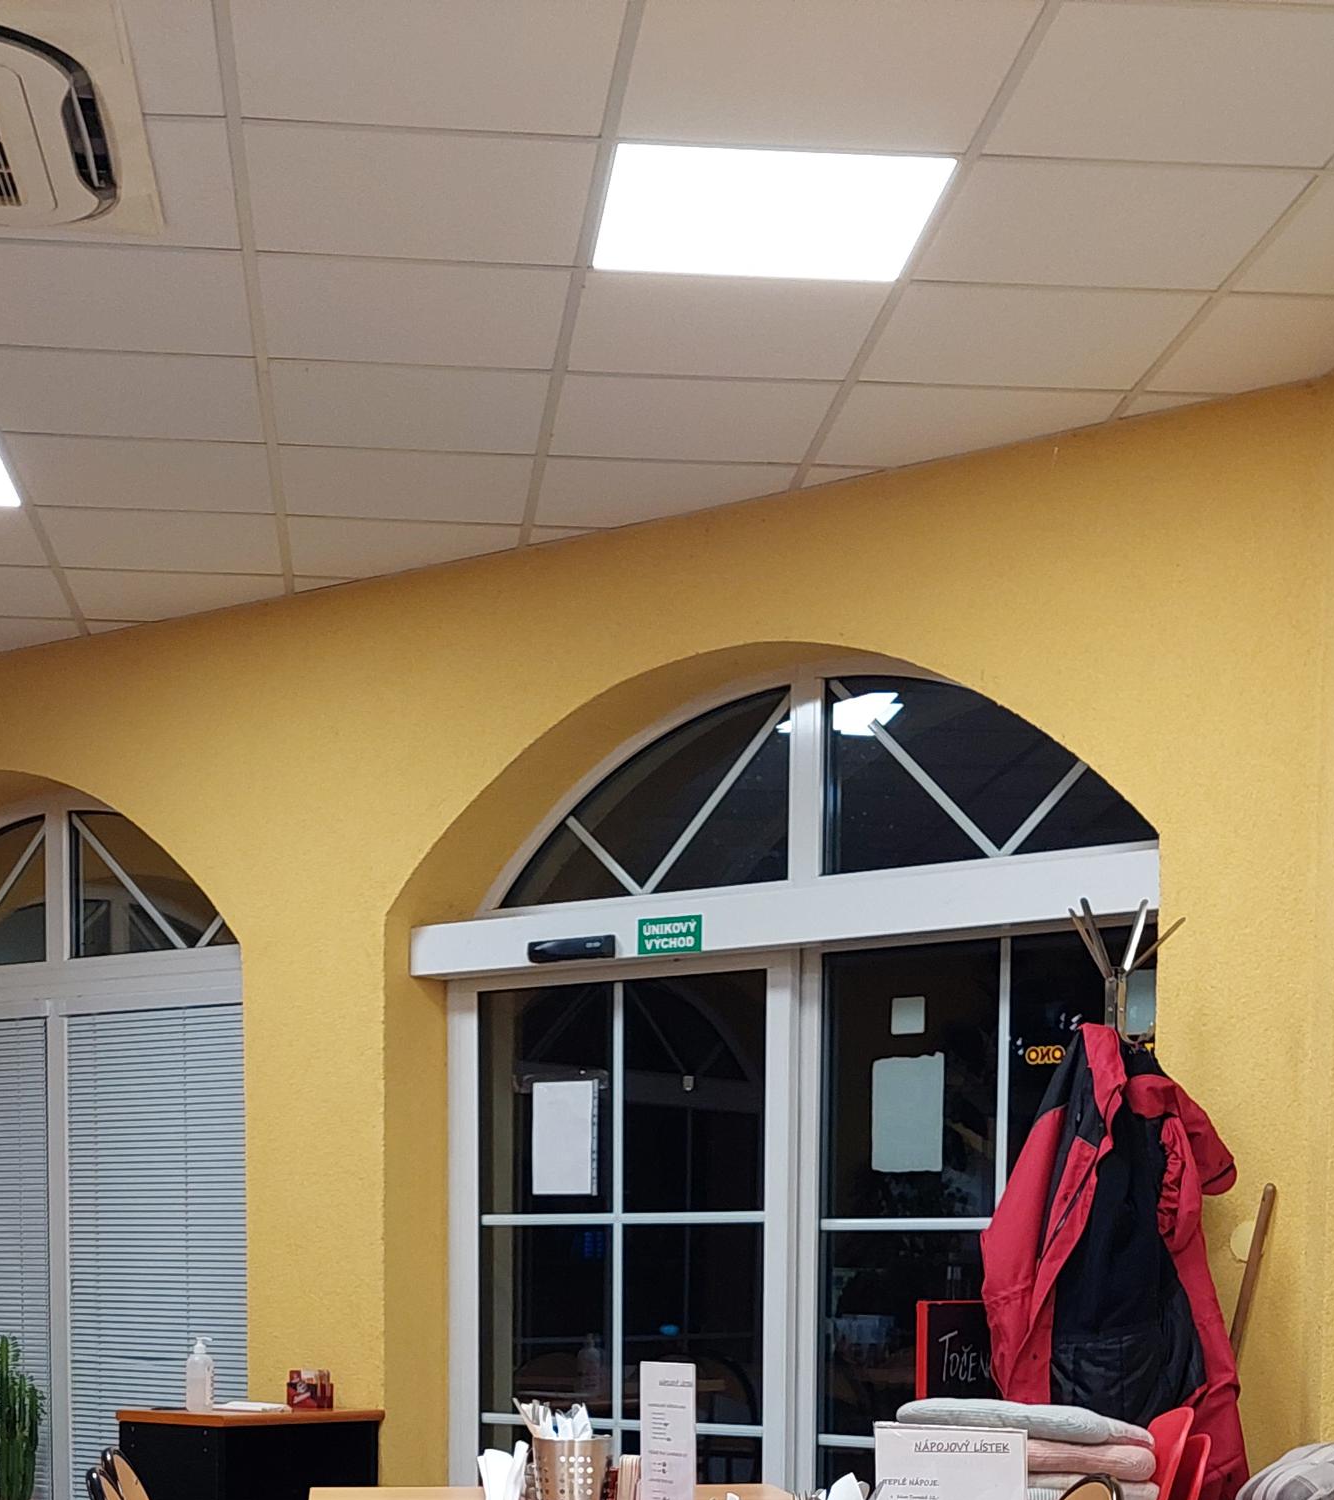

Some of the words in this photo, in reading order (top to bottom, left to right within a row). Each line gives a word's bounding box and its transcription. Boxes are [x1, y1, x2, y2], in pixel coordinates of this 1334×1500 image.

[642, 919, 697, 936] ÚNIKOVÝ
[644, 936, 695, 950] VÝCHOD
[938, 1330, 991, 1382] TOČEN
[914, 1439, 970, 1453] NÁPOJOVÝ
[973, 1439, 1010, 1453] LÍSTEK
